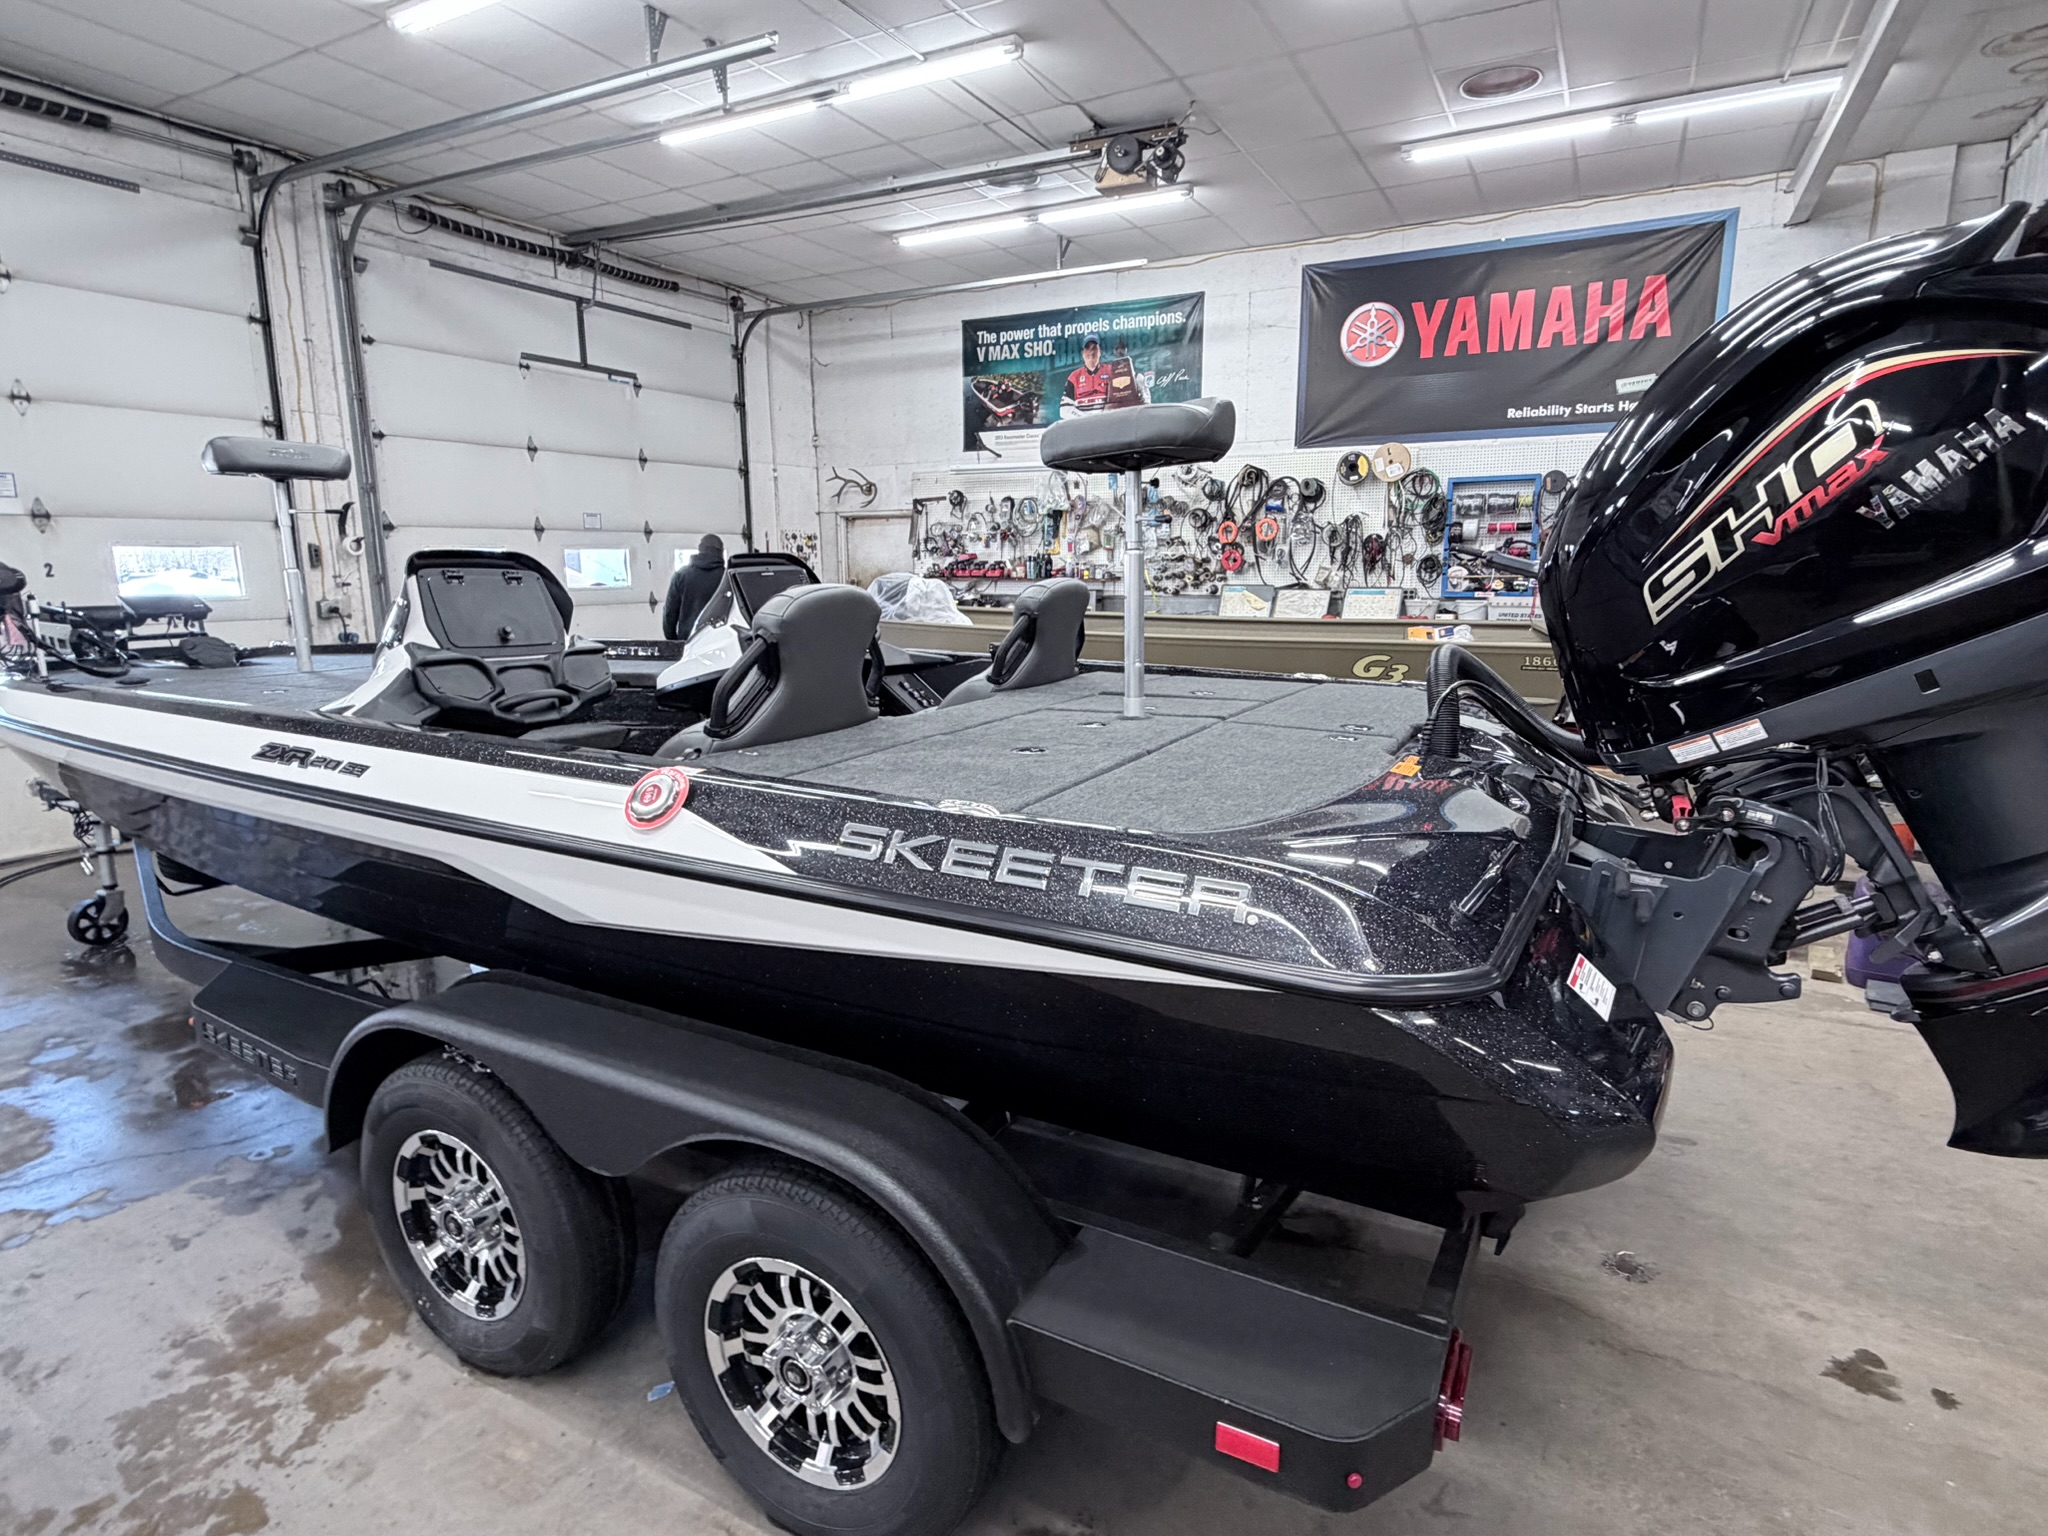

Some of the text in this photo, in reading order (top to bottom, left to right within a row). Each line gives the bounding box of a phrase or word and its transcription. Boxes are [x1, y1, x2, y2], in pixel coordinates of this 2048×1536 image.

[976, 310, 1187, 345] The power that propels champions.
[1412, 274, 1672, 359] YAMAHA
[976, 346, 986, 362] V
[988, 343, 1020, 362] MAX
[1024, 339, 1056, 358] SHO.
[1506, 404, 1572, 418] Reliability
[1575, 402, 1615, 414] Starts
[1855, 408, 2027, 530] YAMAHA
[1643, 398, 1884, 626] SHO
[43, 562, 55, 578] 2
[1352, 654, 1410, 683] G3
[834, 821, 1253, 924] SKEETER
[202, 1022, 298, 1086] SKEETER
